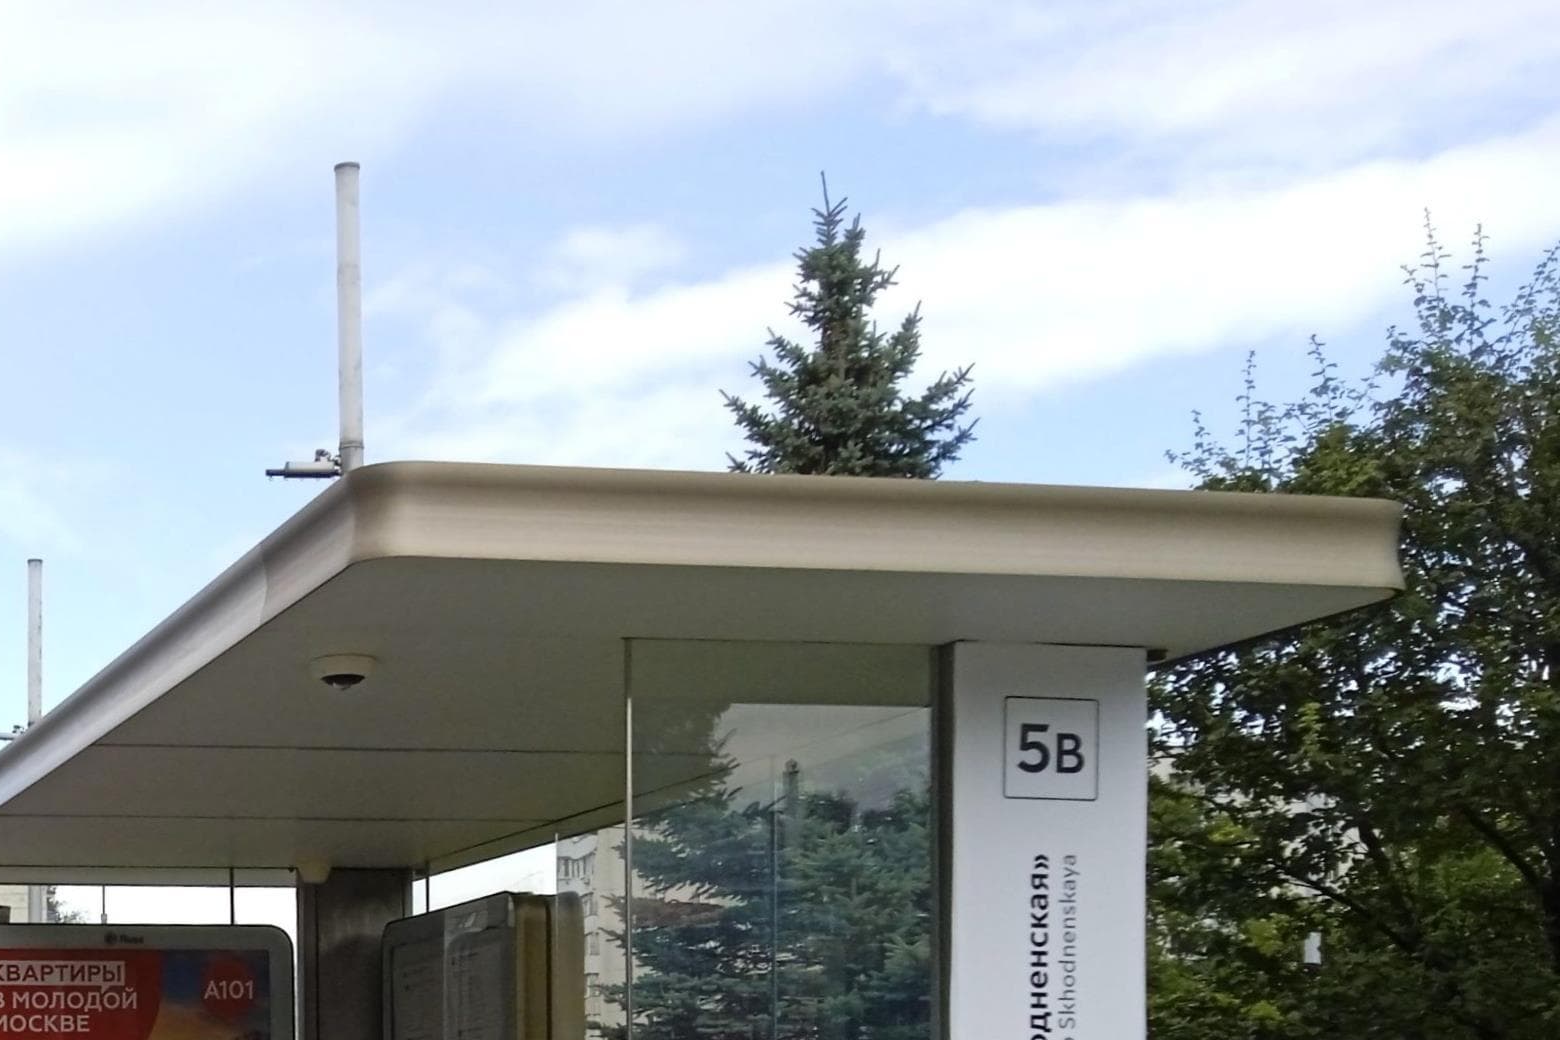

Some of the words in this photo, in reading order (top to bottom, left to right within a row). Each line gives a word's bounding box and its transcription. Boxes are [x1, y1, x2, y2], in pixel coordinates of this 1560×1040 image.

[1058, 854, 1080, 1029] Skhodnenskaya
[12, 987, 137, 1012] МОЛОДОЙ
[203, 980, 254, 1000] А101
